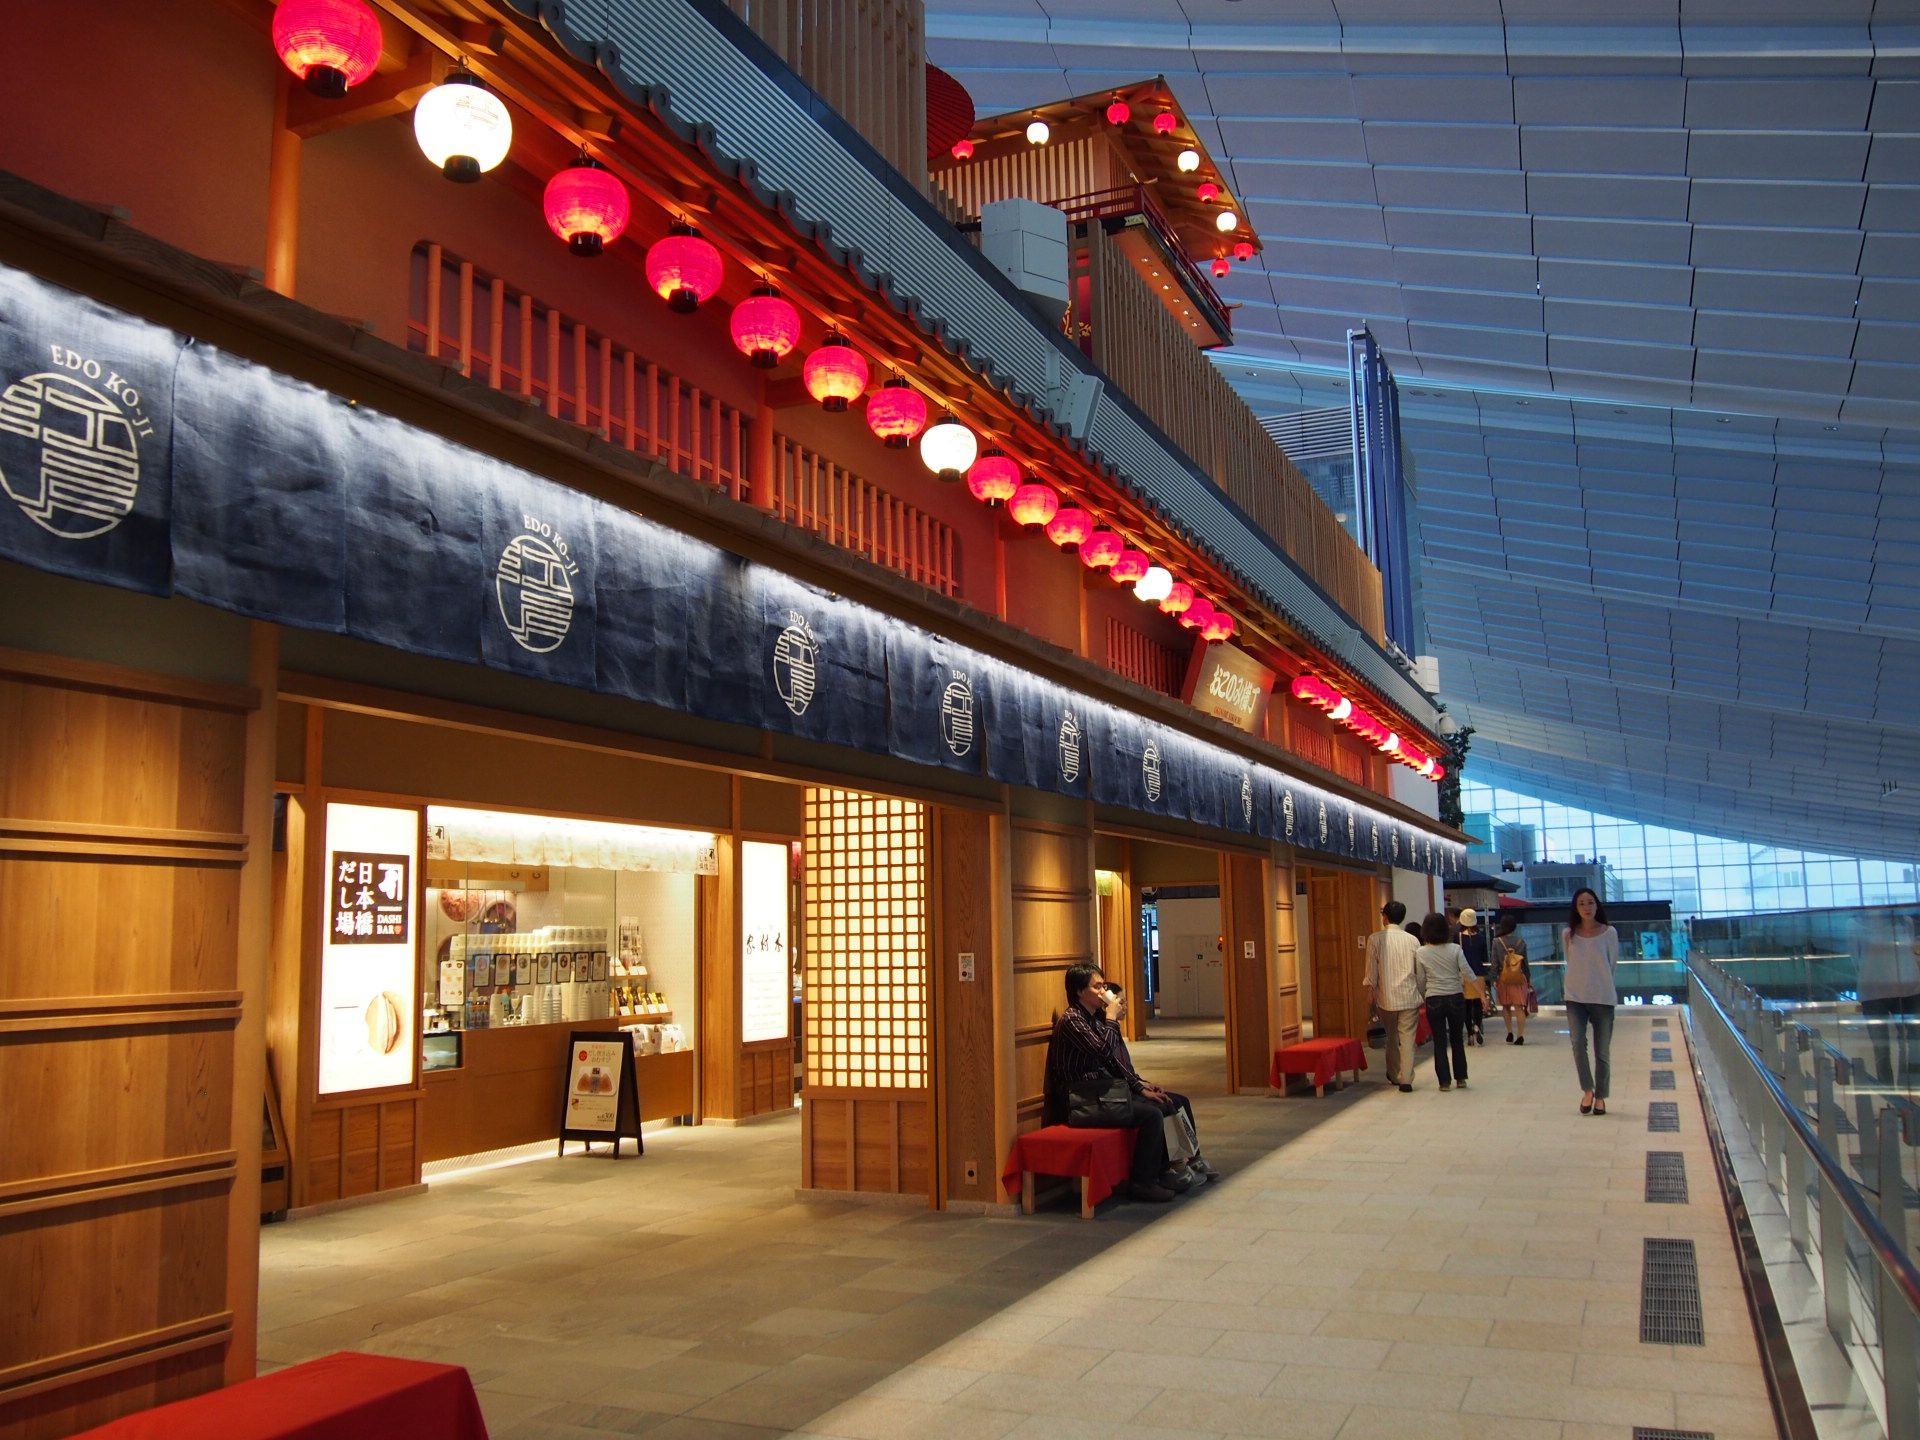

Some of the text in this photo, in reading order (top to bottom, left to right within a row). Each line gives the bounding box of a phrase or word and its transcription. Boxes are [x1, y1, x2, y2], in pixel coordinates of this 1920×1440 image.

[50, 344, 154, 438] EDO KO-JI
[523, 513, 580, 576] EDO KO-JI
[789, 610, 805, 627] EDO
[335, 860, 357, 936] だし場
[355, 862, 375, 936] 日本橋
[377, 914, 402, 924] DASHI
[377, 924, 395, 935] BAR
